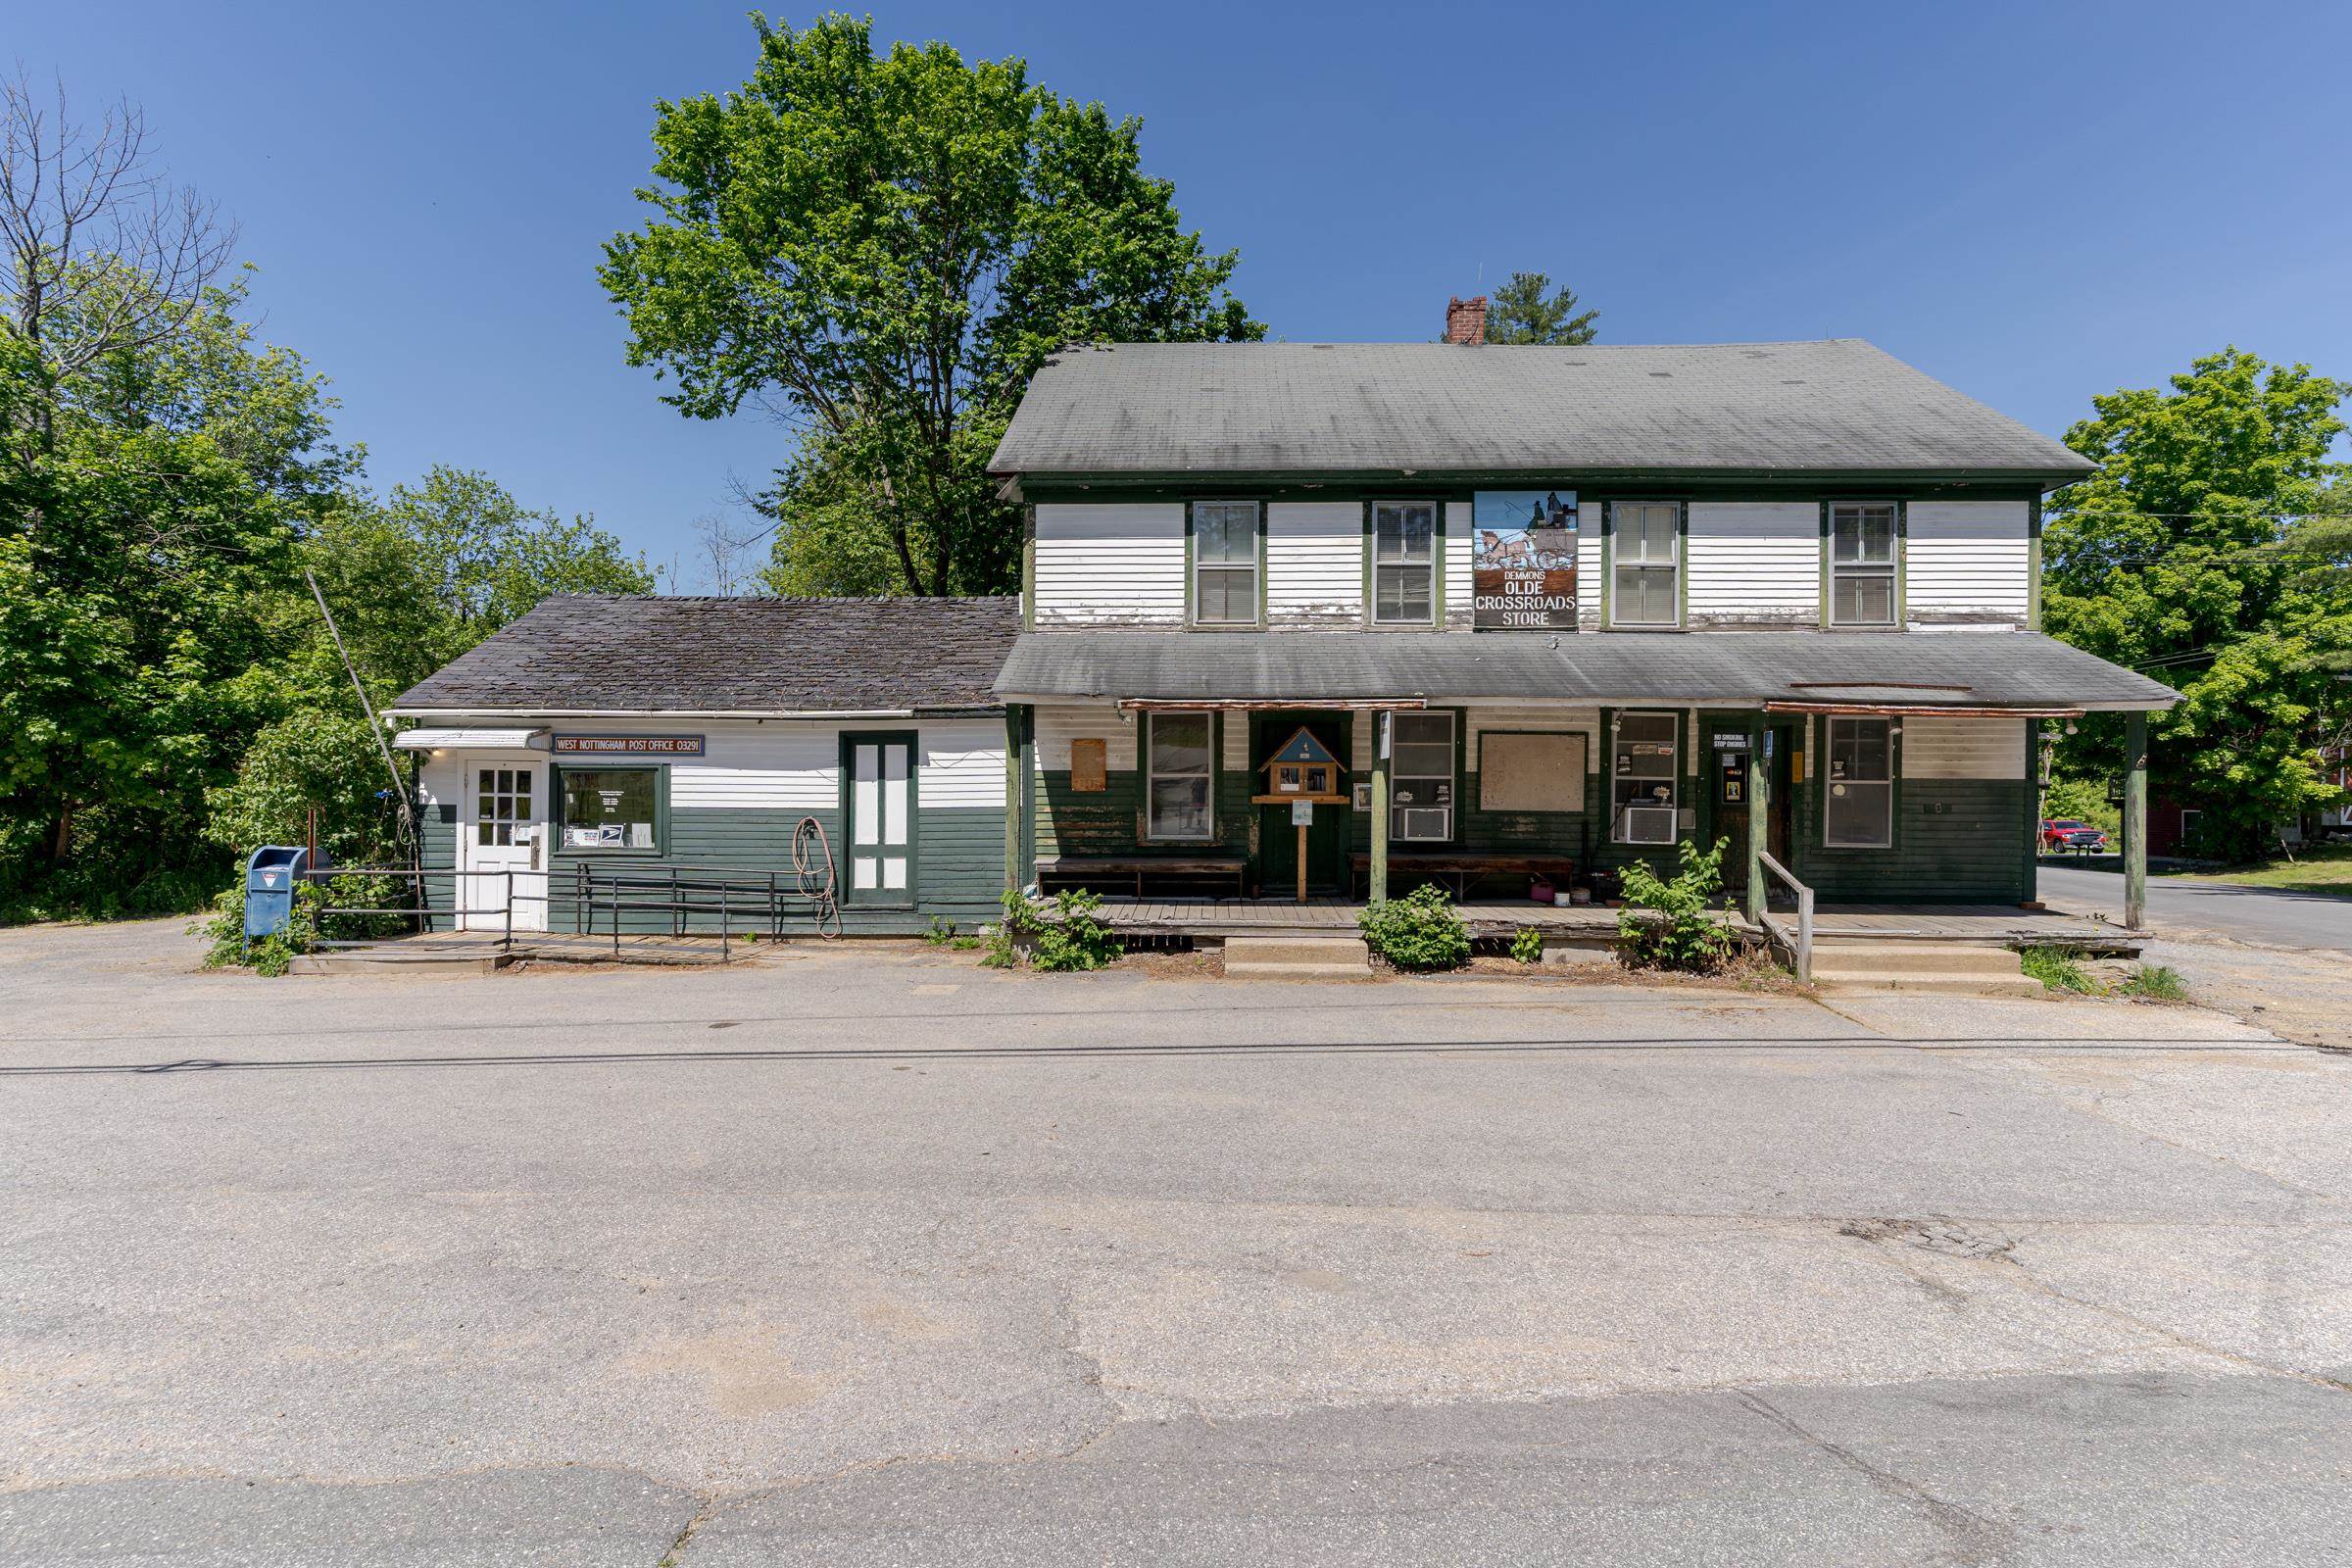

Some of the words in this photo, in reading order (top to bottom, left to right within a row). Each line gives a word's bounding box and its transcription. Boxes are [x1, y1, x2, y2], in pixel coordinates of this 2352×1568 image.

[1504, 571, 1545, 580] DEMMONS
[1505, 581, 1544, 595] OLDE
[1475, 596, 1576, 610] CROSSROADS
[1502, 612, 1549, 625] STORE
[557, 739, 577, 750] WEST
[579, 739, 626, 750] NOTTINGHAM
[629, 740, 648, 751] POST
[648, 740, 673, 751] OFFICE
[676, 740, 699, 751] 03291
